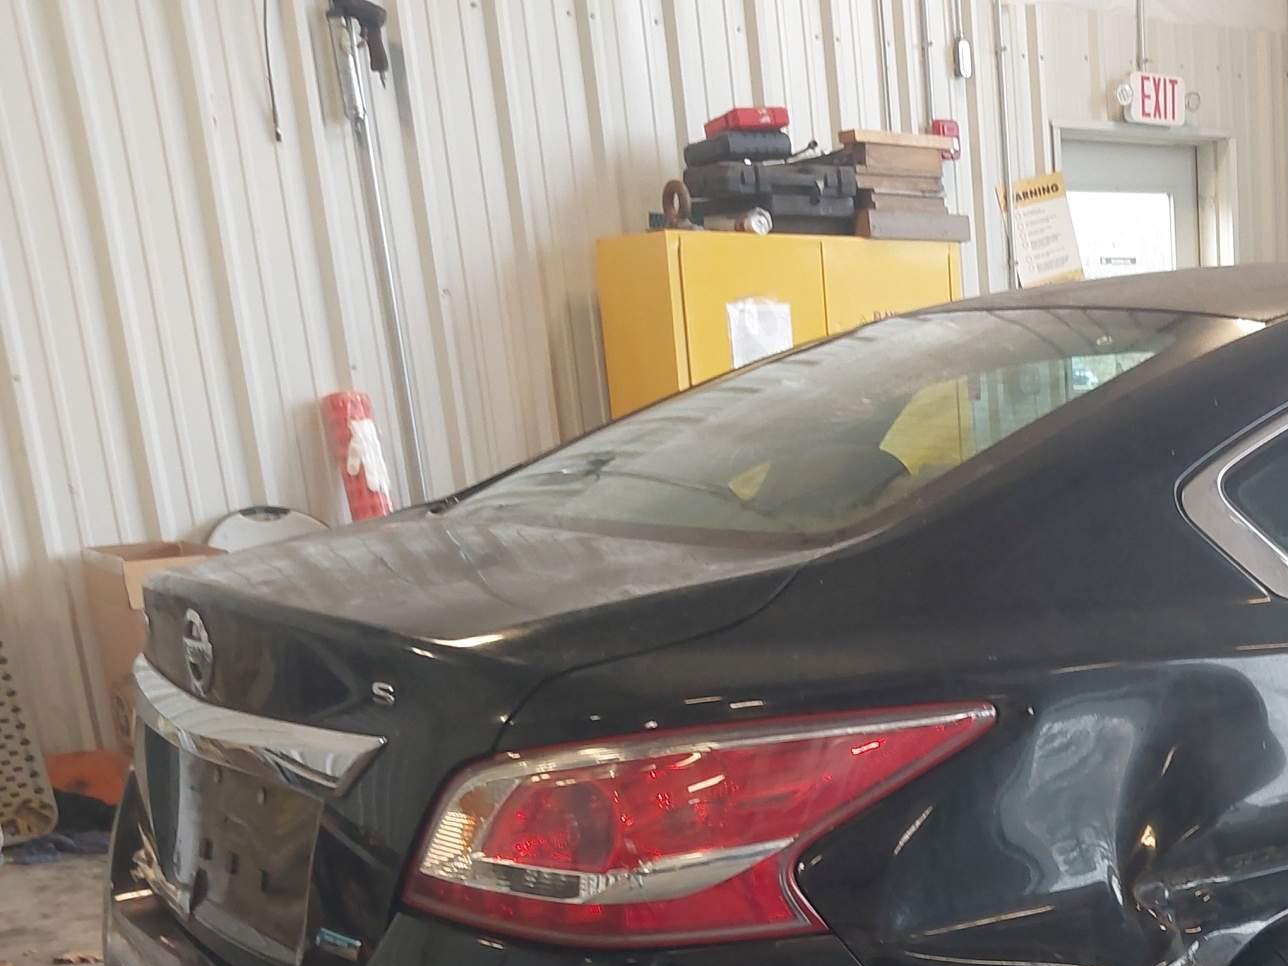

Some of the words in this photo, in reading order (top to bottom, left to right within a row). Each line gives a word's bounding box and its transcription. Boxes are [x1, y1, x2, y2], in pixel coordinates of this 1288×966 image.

[1141, 75, 1178, 121] EXIT
[1014, 183, 1060, 203] ARNING
[372, 681, 395, 704] S
